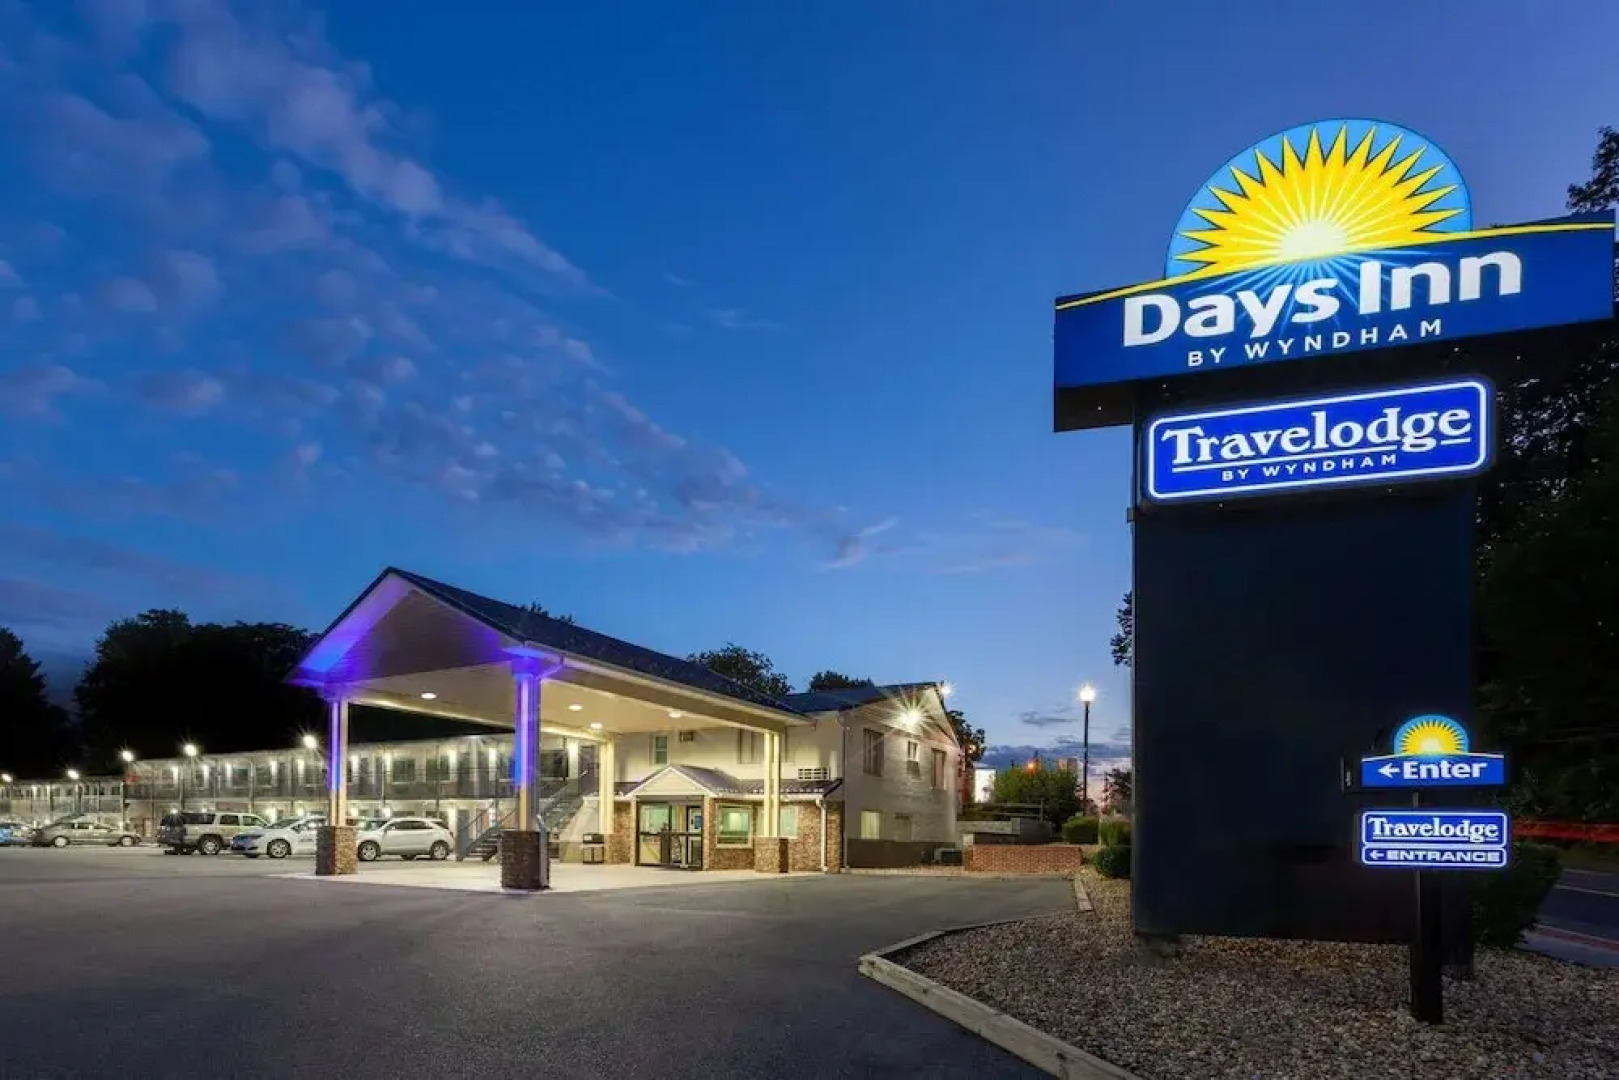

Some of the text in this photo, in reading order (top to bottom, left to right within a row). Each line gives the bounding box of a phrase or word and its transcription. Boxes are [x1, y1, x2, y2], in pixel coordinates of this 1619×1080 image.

[1123, 250, 1521, 347] Days Inn
[1187, 318, 1443, 368] BY WYNDHAM
[1162, 407, 1471, 465] Travelodge
[1220, 453, 1397, 482] BY WYNDHAM
[1402, 761, 1488, 780] Enter
[1367, 817, 1499, 843] Travelodge
[1385, 849, 1500, 862] ENTRANCE
